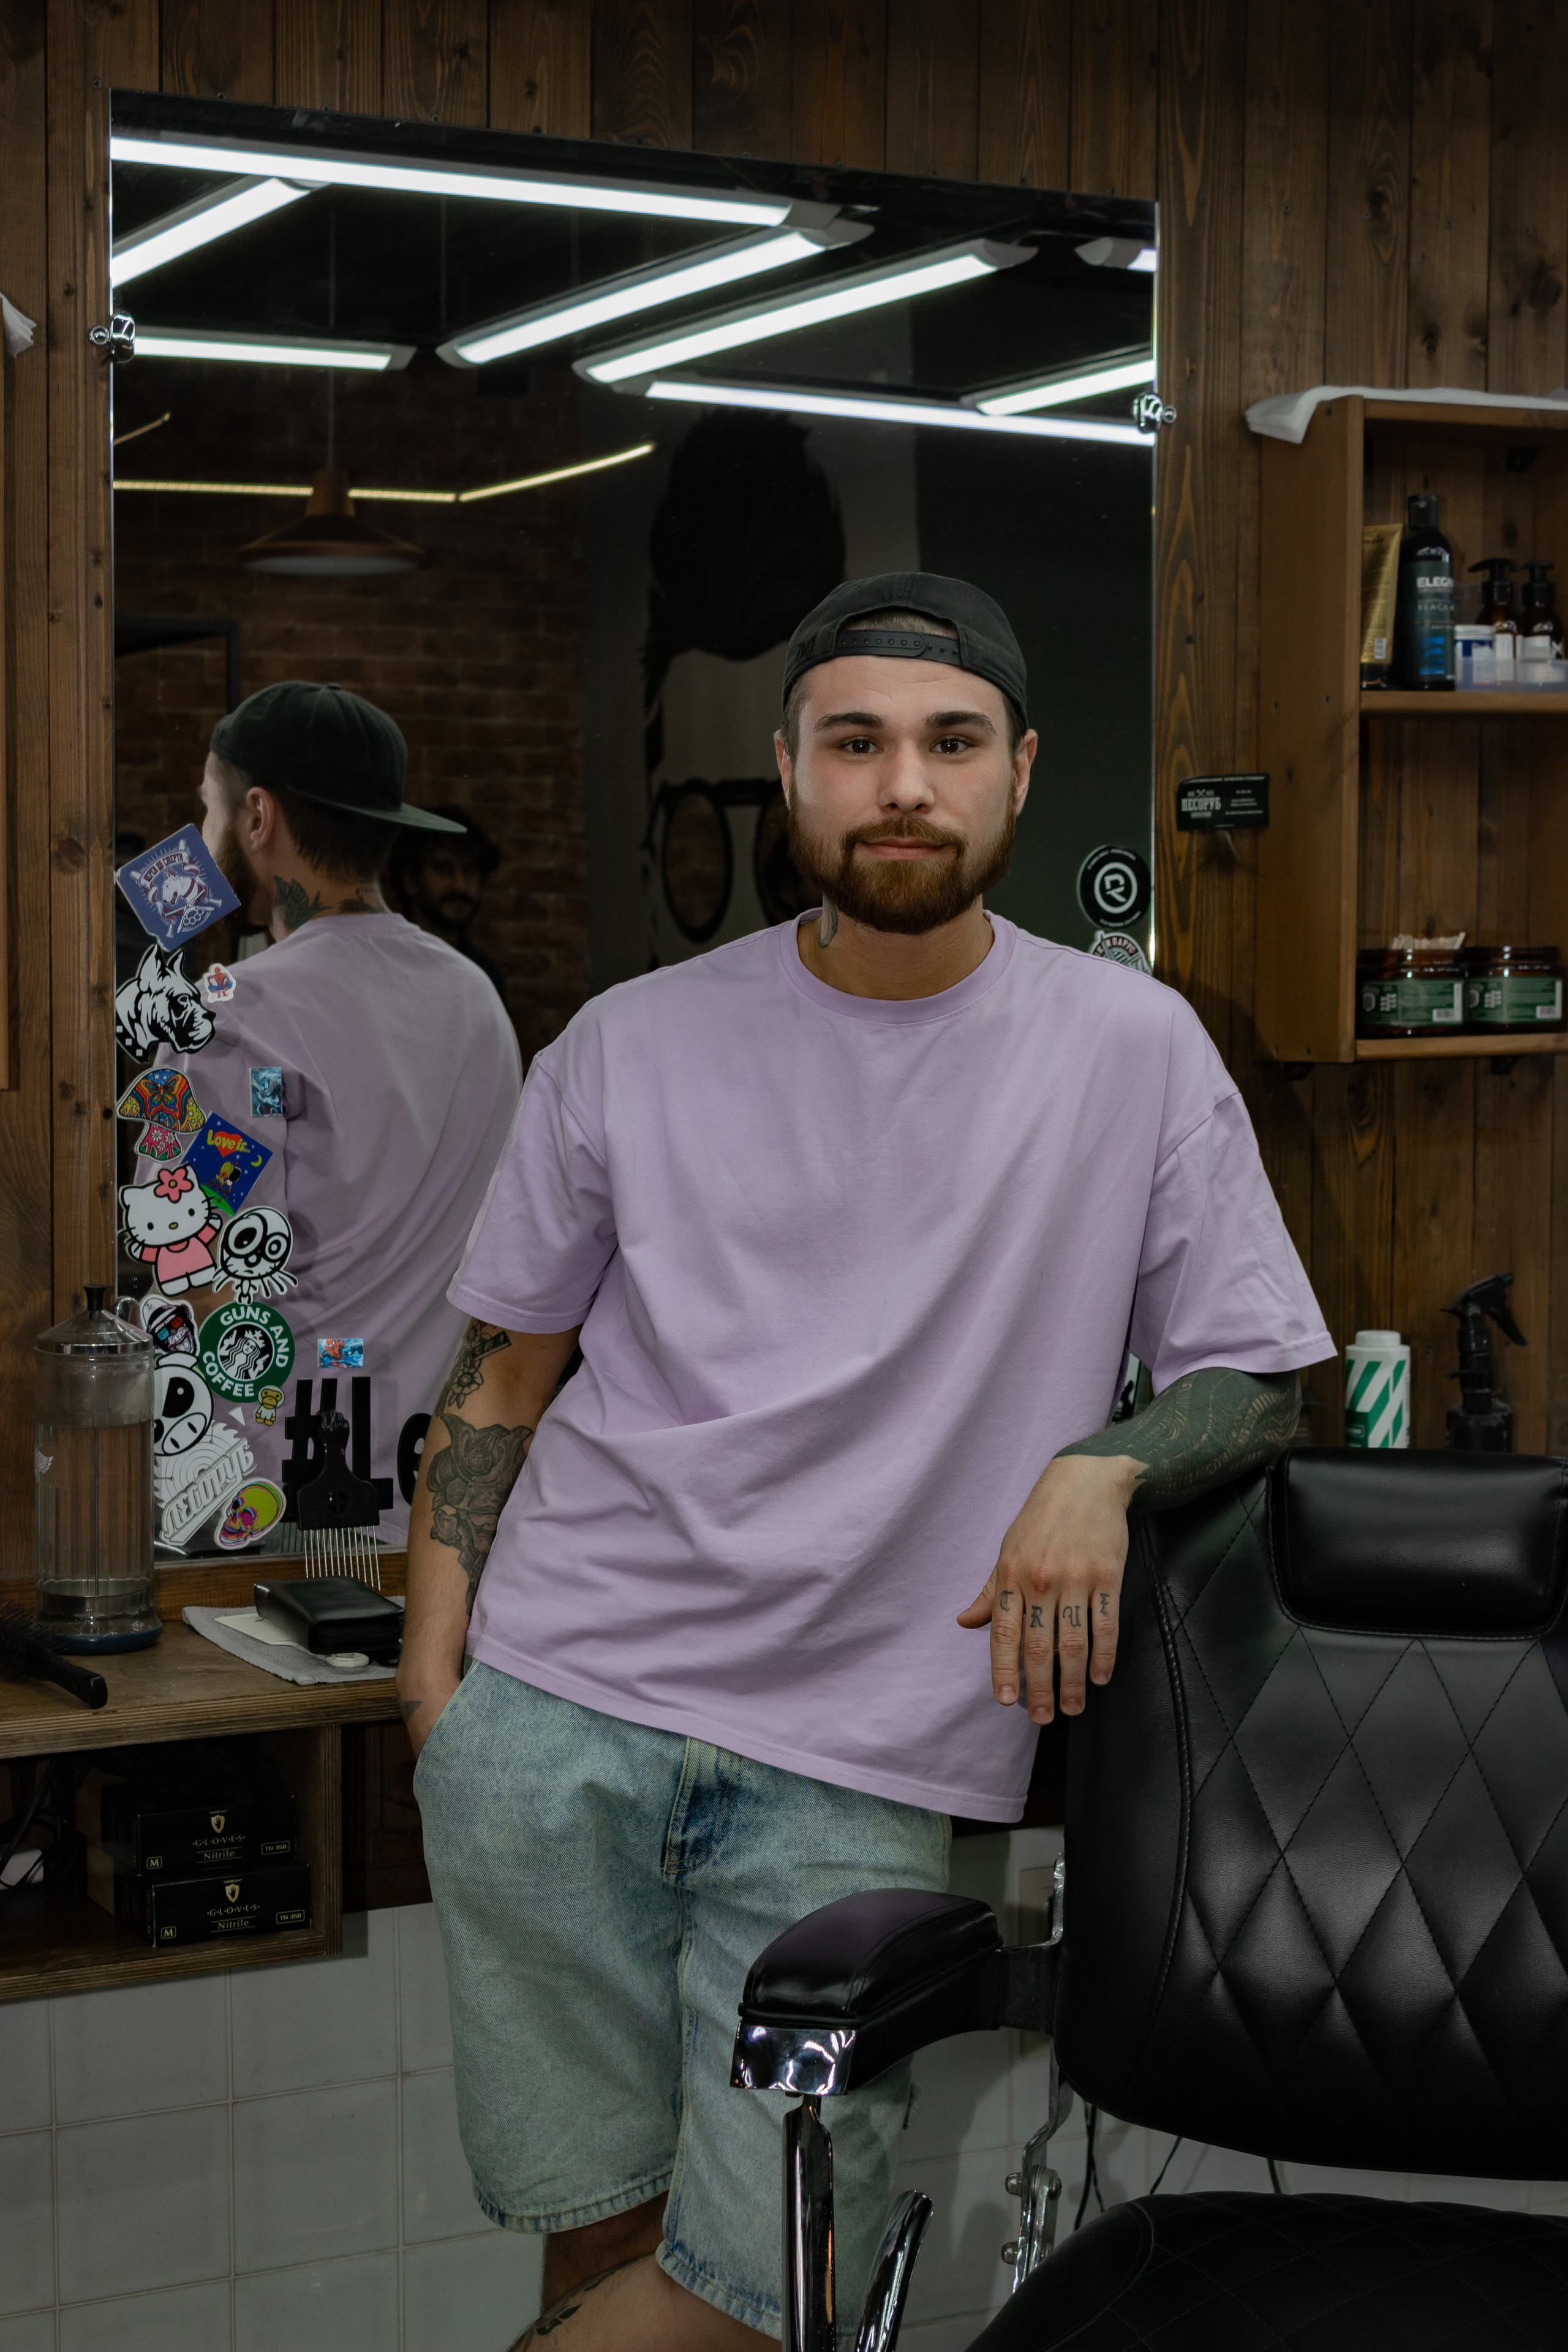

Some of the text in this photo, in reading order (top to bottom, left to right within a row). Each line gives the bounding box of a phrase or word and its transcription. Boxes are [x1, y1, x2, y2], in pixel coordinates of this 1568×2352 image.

[207, 1129, 236, 1150] Love
[220, 1306, 290, 1368] GUNS AND
[203, 1351, 254, 1397] COFFEE
[161, 1437, 257, 1540] ЛЕСОРУБ
[149, 1858, 159, 1868] M
[203, 1849, 235, 1861] Nitrile
[218, 1918, 250, 1930] Nitrile
[164, 1928, 173, 1937] M
